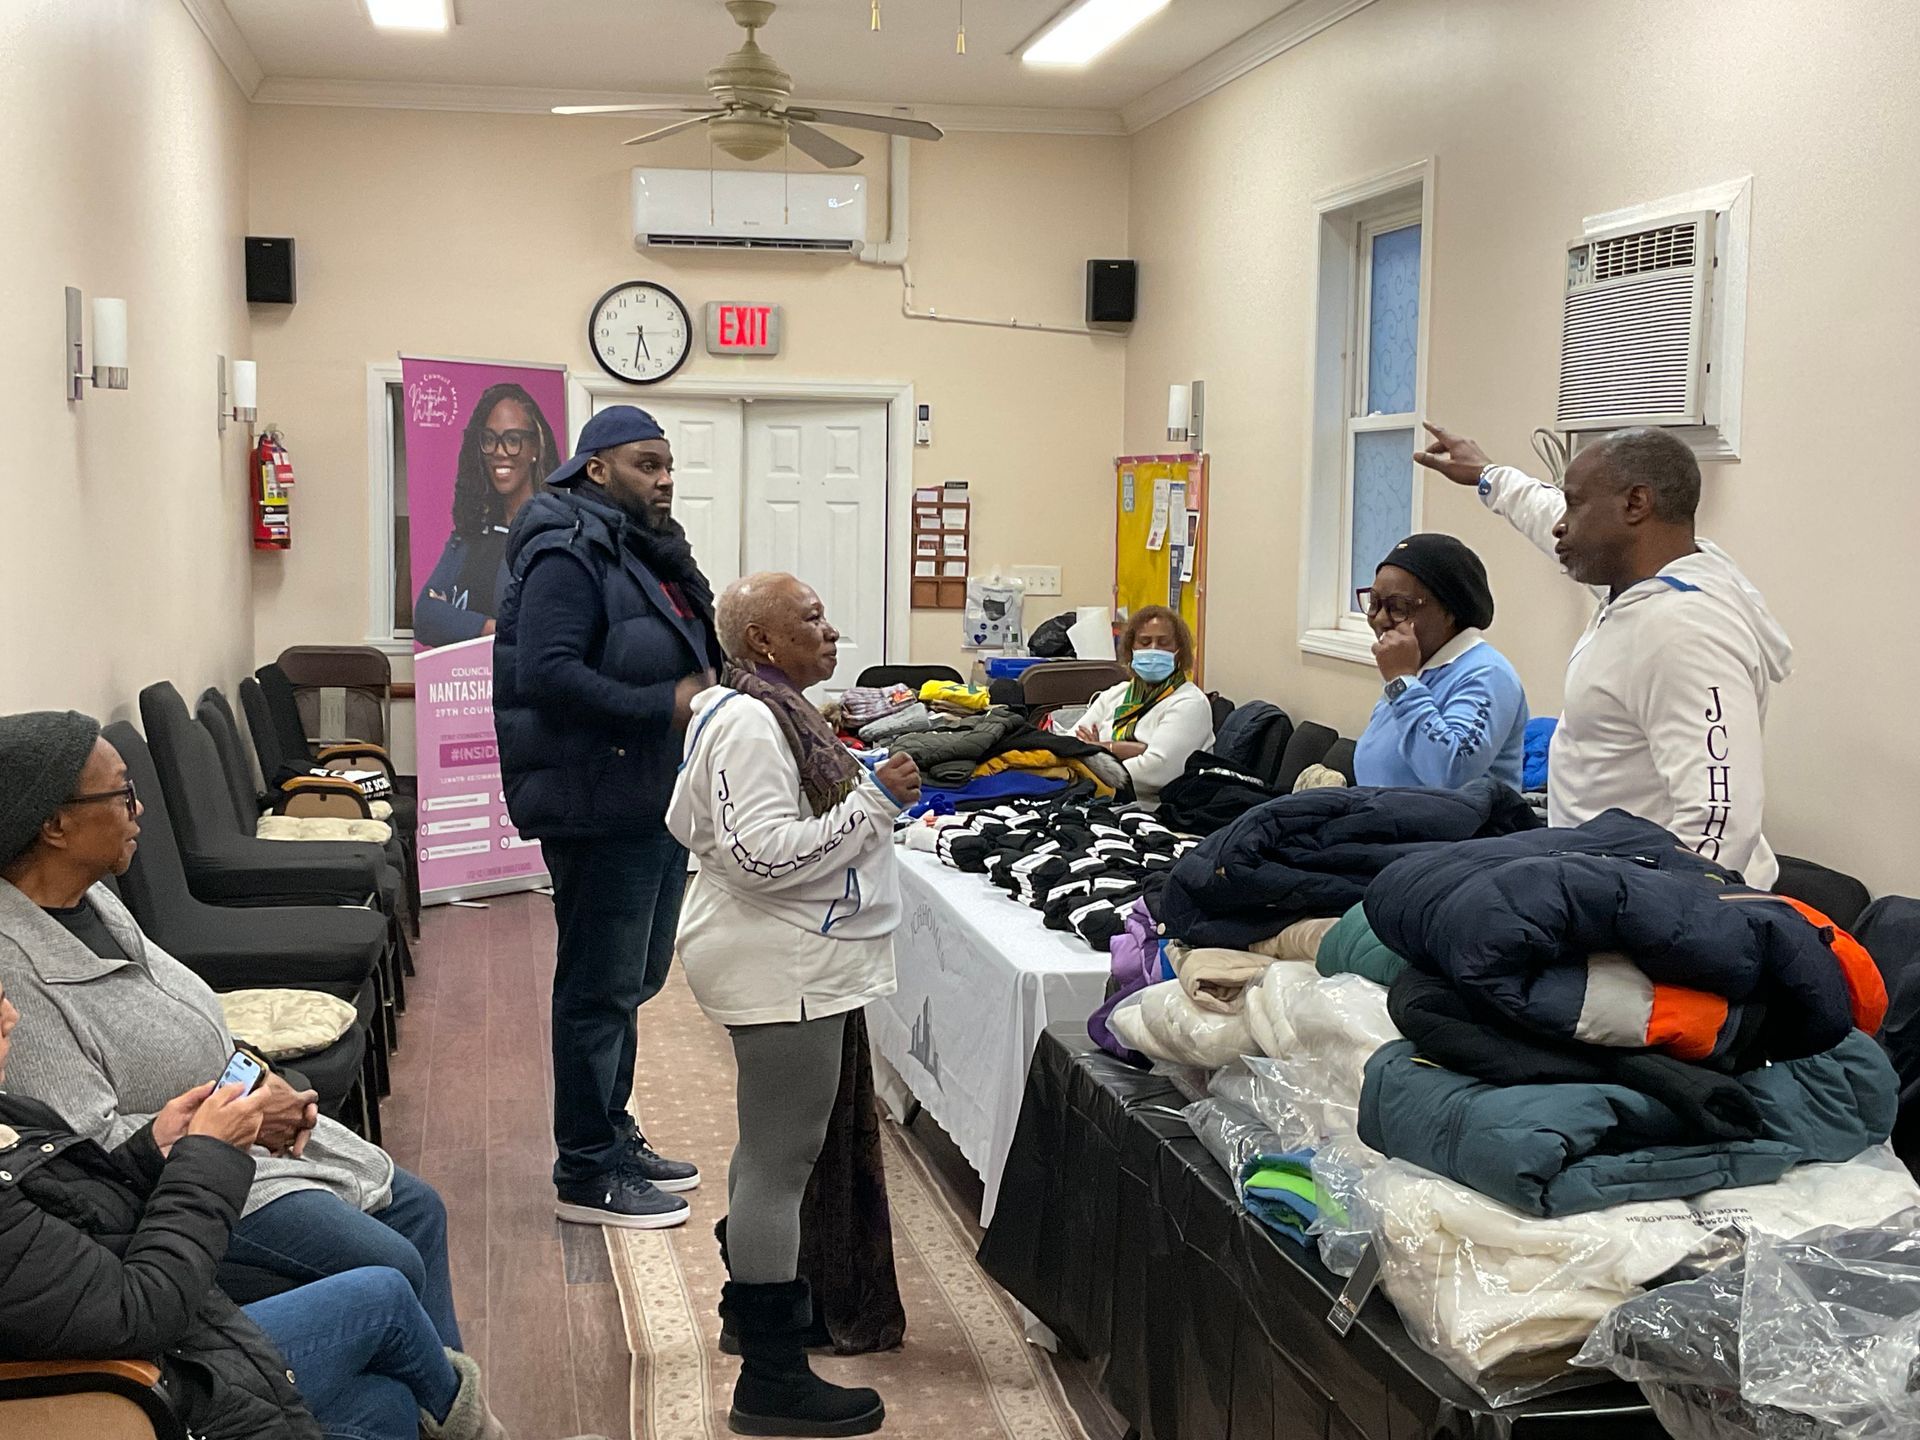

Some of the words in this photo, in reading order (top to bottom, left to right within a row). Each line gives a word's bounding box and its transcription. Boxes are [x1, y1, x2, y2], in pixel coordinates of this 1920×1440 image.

[619, 298, 627, 308] 11
[635, 293, 646, 303] 12
[606, 310, 618, 320] 10
[667, 311, 674, 321] 2
[719, 306, 771, 347] EXIT
[601, 328, 609, 338] 9
[671, 328, 680, 338] 3
[607, 346, 616, 356] 8
[666, 346, 674, 356] 4
[621, 358, 628, 368] 7
[637, 363, 646, 373] 6
[655, 358, 662, 368] 5
[451, 666, 491, 677] COUNCIL
[429, 680, 493, 703] NANTASHA
